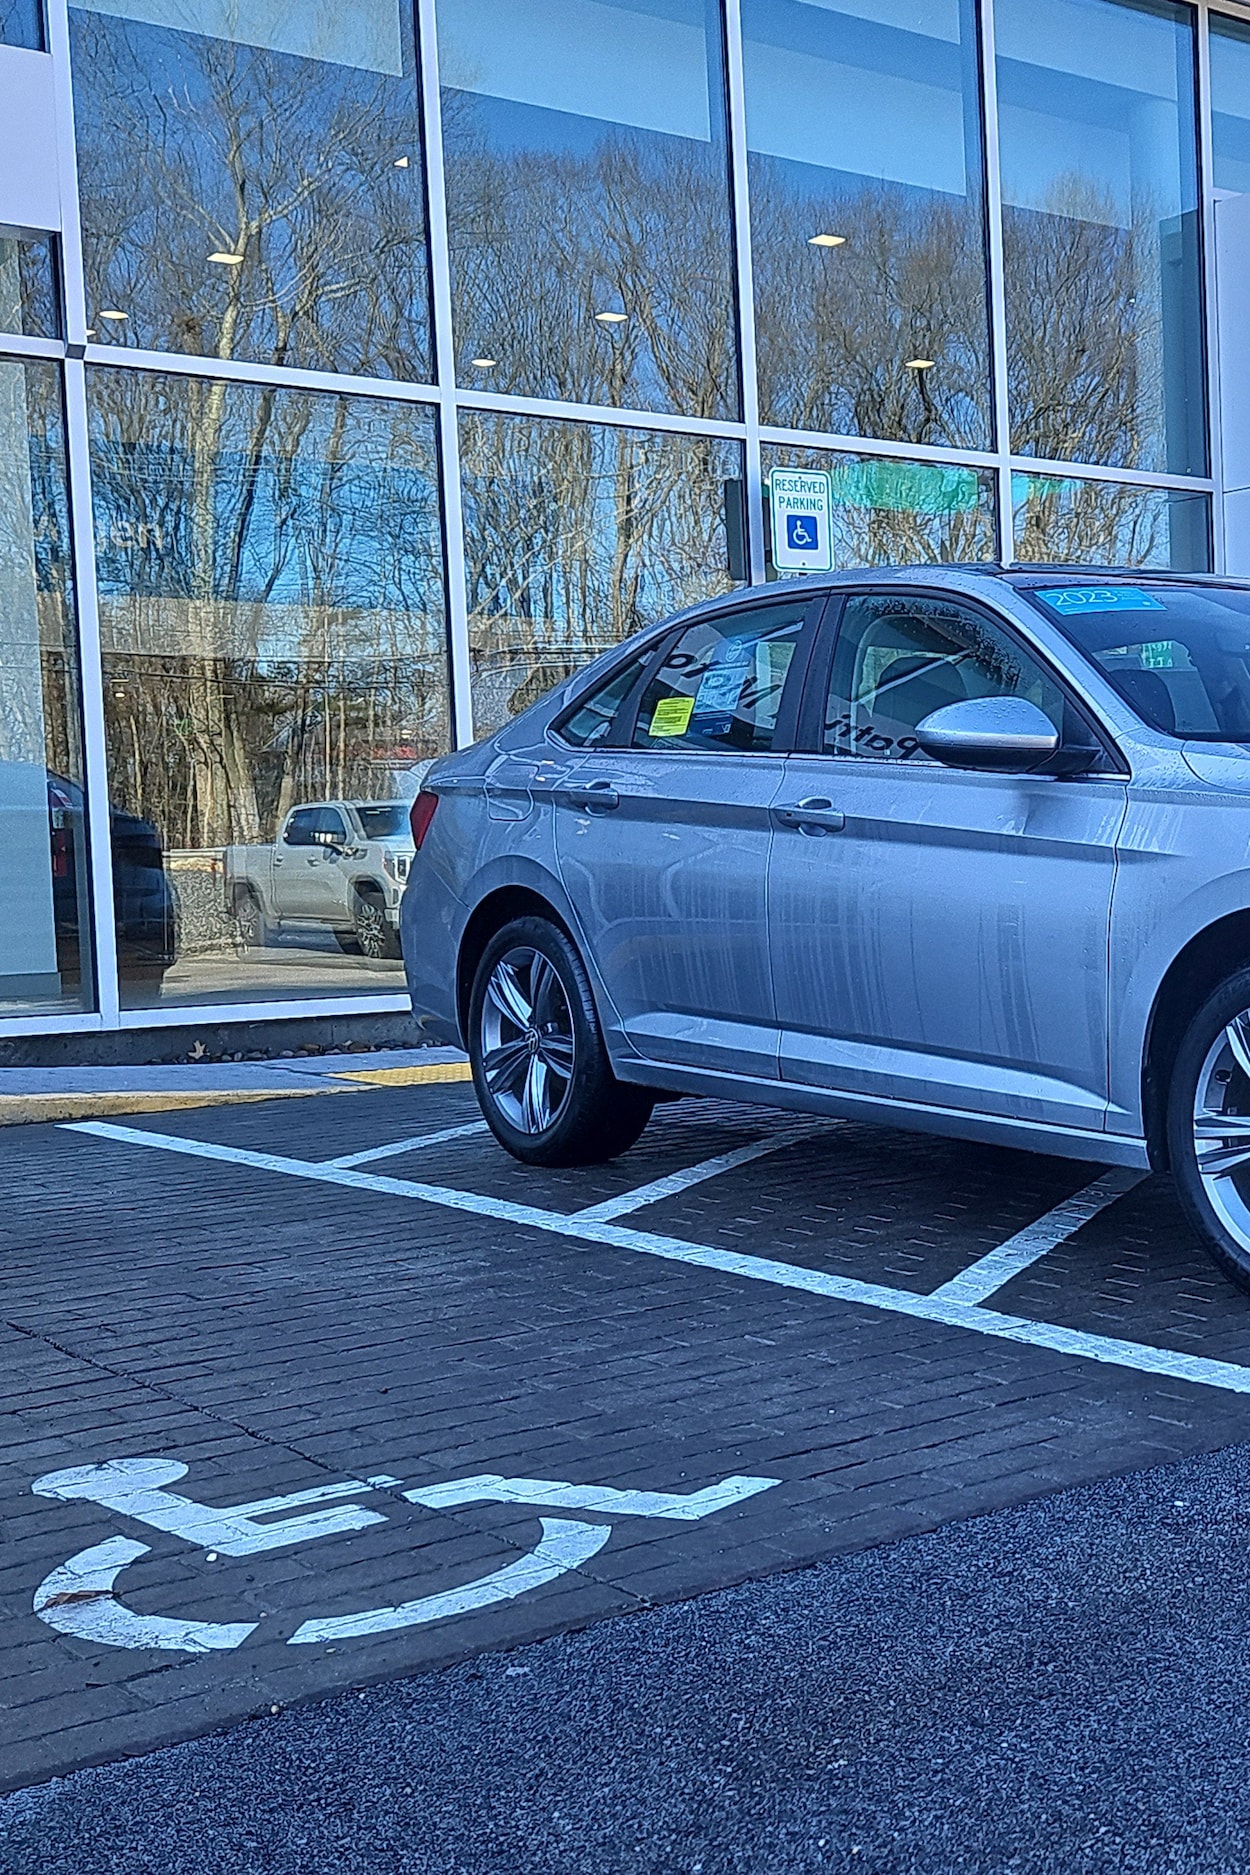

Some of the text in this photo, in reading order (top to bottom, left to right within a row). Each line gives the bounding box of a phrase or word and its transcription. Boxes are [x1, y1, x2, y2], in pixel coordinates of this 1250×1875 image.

[775, 478, 825, 495] RESERVED
[778, 495, 823, 511] PARKING
[1045, 590, 1118, 606] 2023
